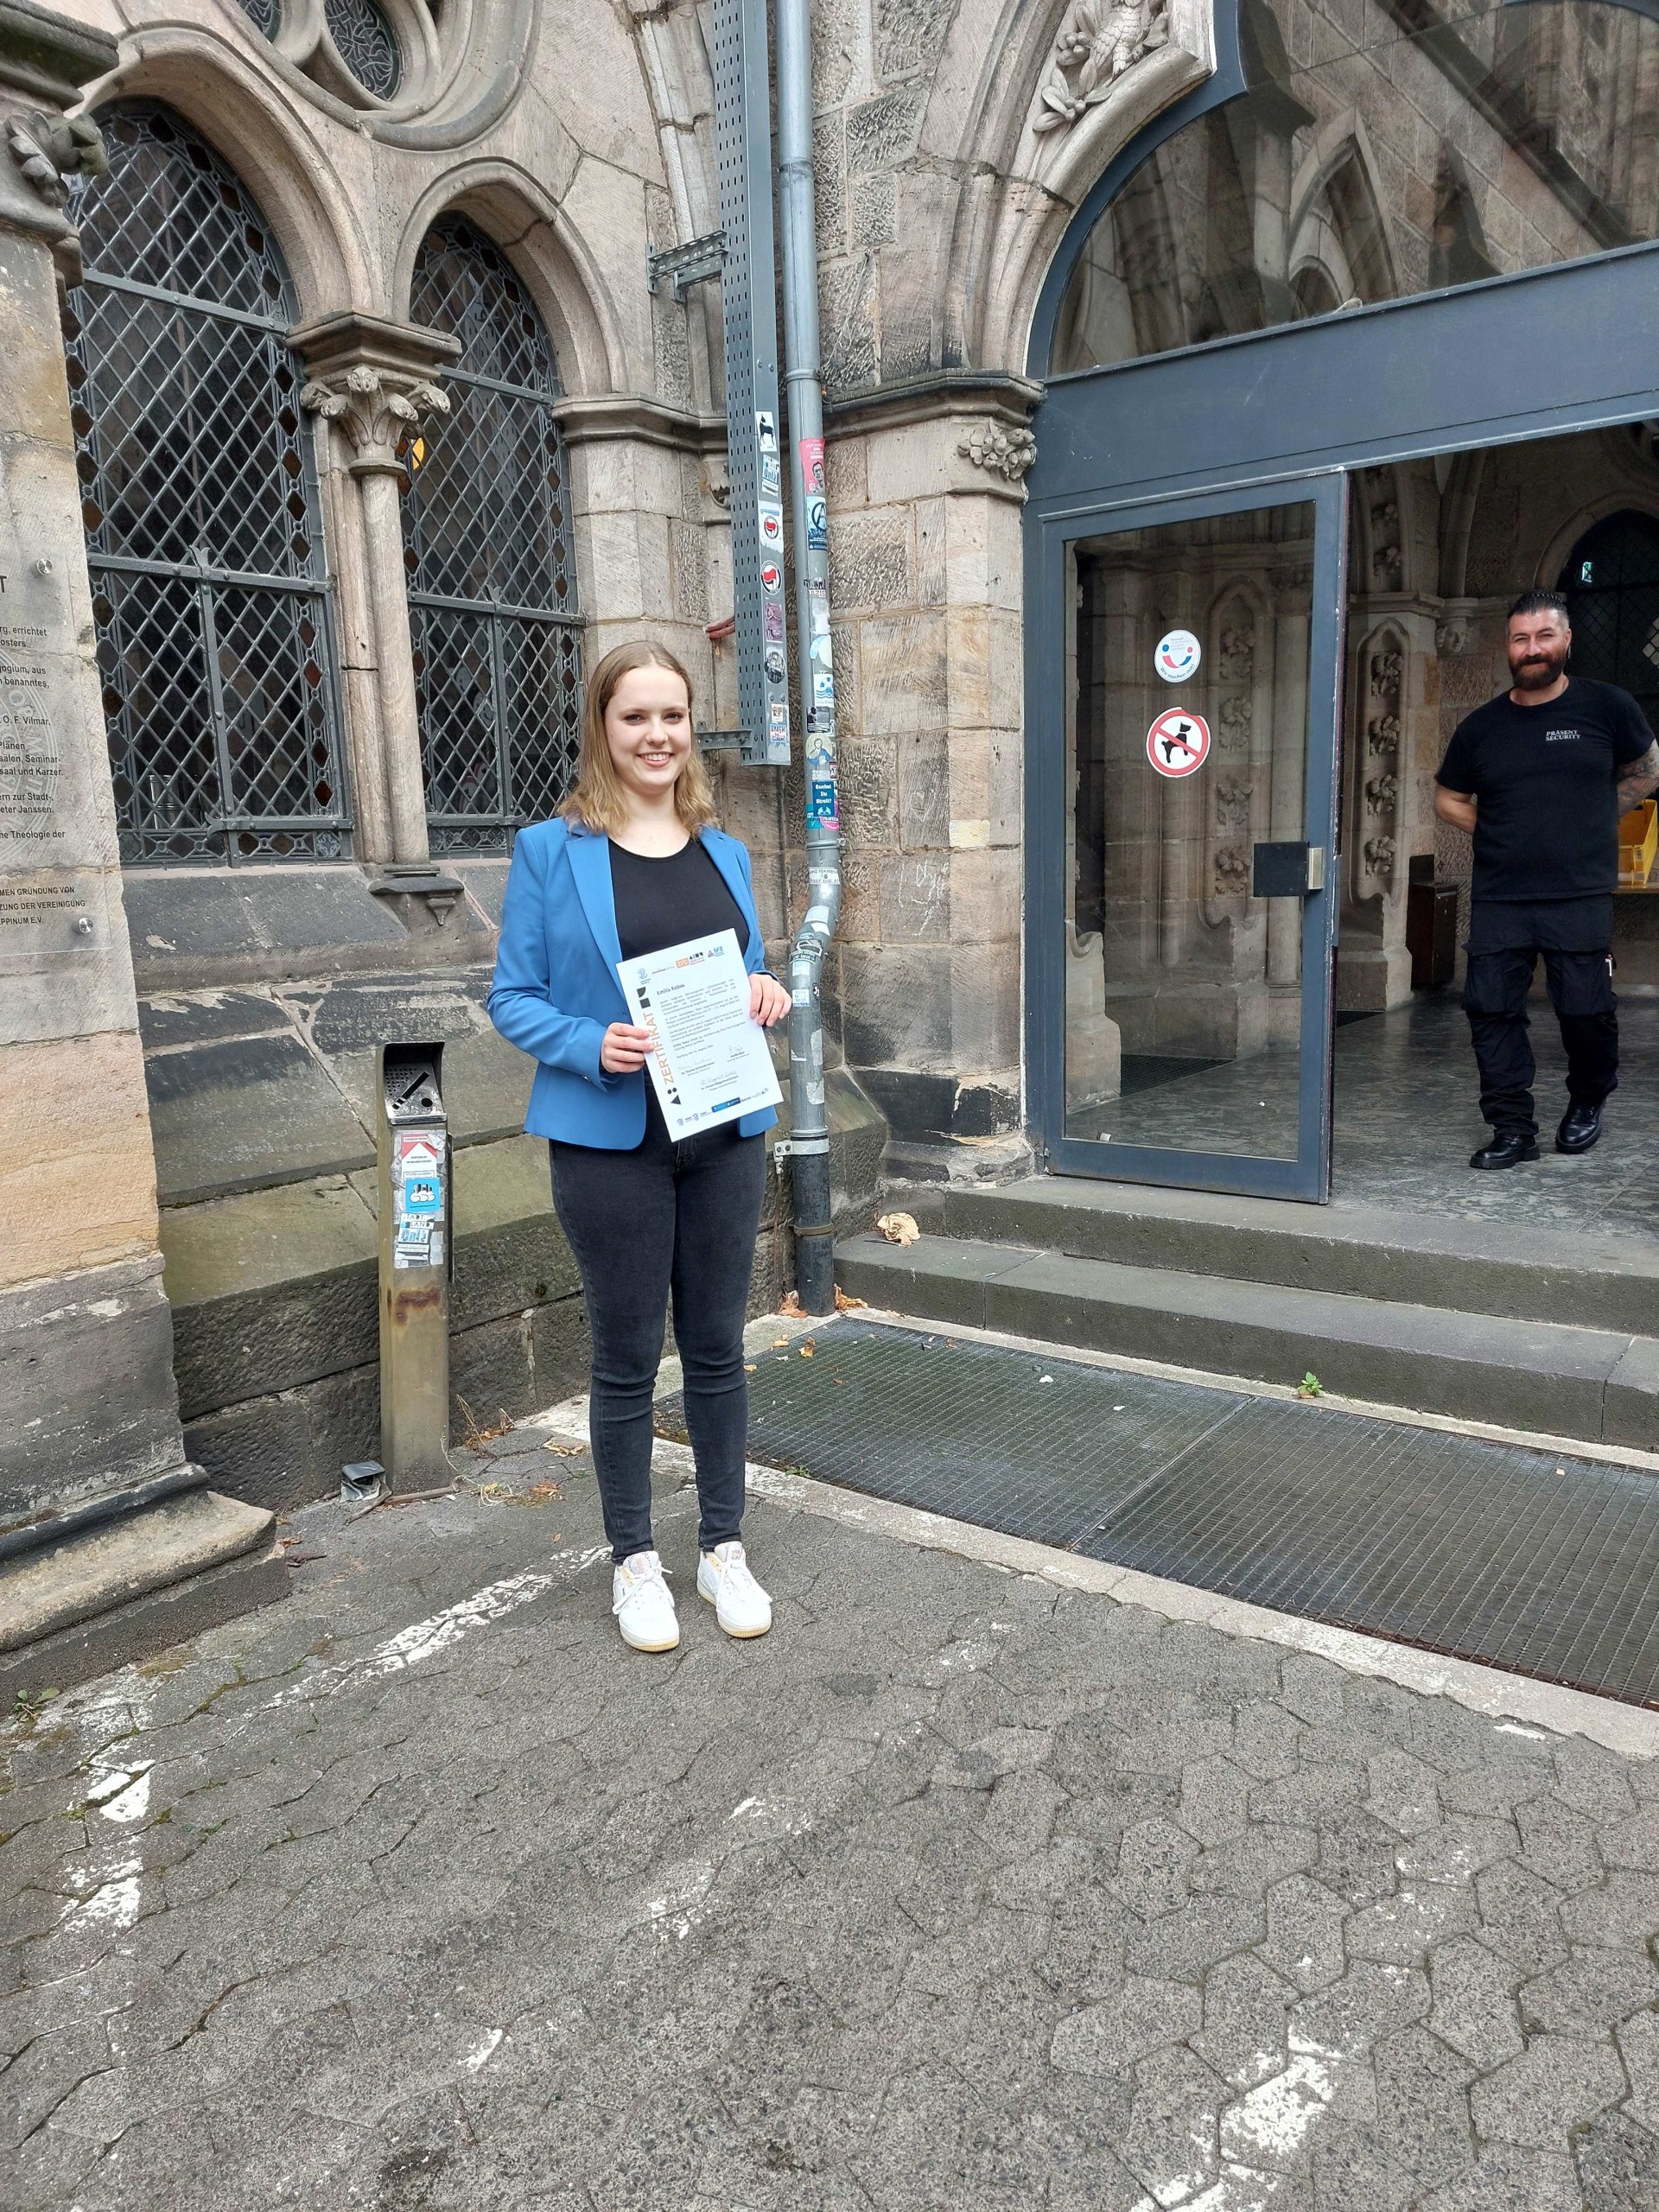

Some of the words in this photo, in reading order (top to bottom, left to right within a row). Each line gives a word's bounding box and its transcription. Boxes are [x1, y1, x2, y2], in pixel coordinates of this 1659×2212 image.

[13, 626, 47, 636] errichtet
[5, 677, 49, 689] benanntes,
[22, 716, 51, 725] Vilmar.
[25, 754, 60, 763] Seminar-
[35, 767, 63, 776] Karzer.
[10, 830, 50, 841] Theologie
[17, 887, 58, 896] GRÜNDUNG
[37, 899, 85, 909] VEREINIGUNG
[643, 1013, 675, 1085] ZERTIFIKAT
